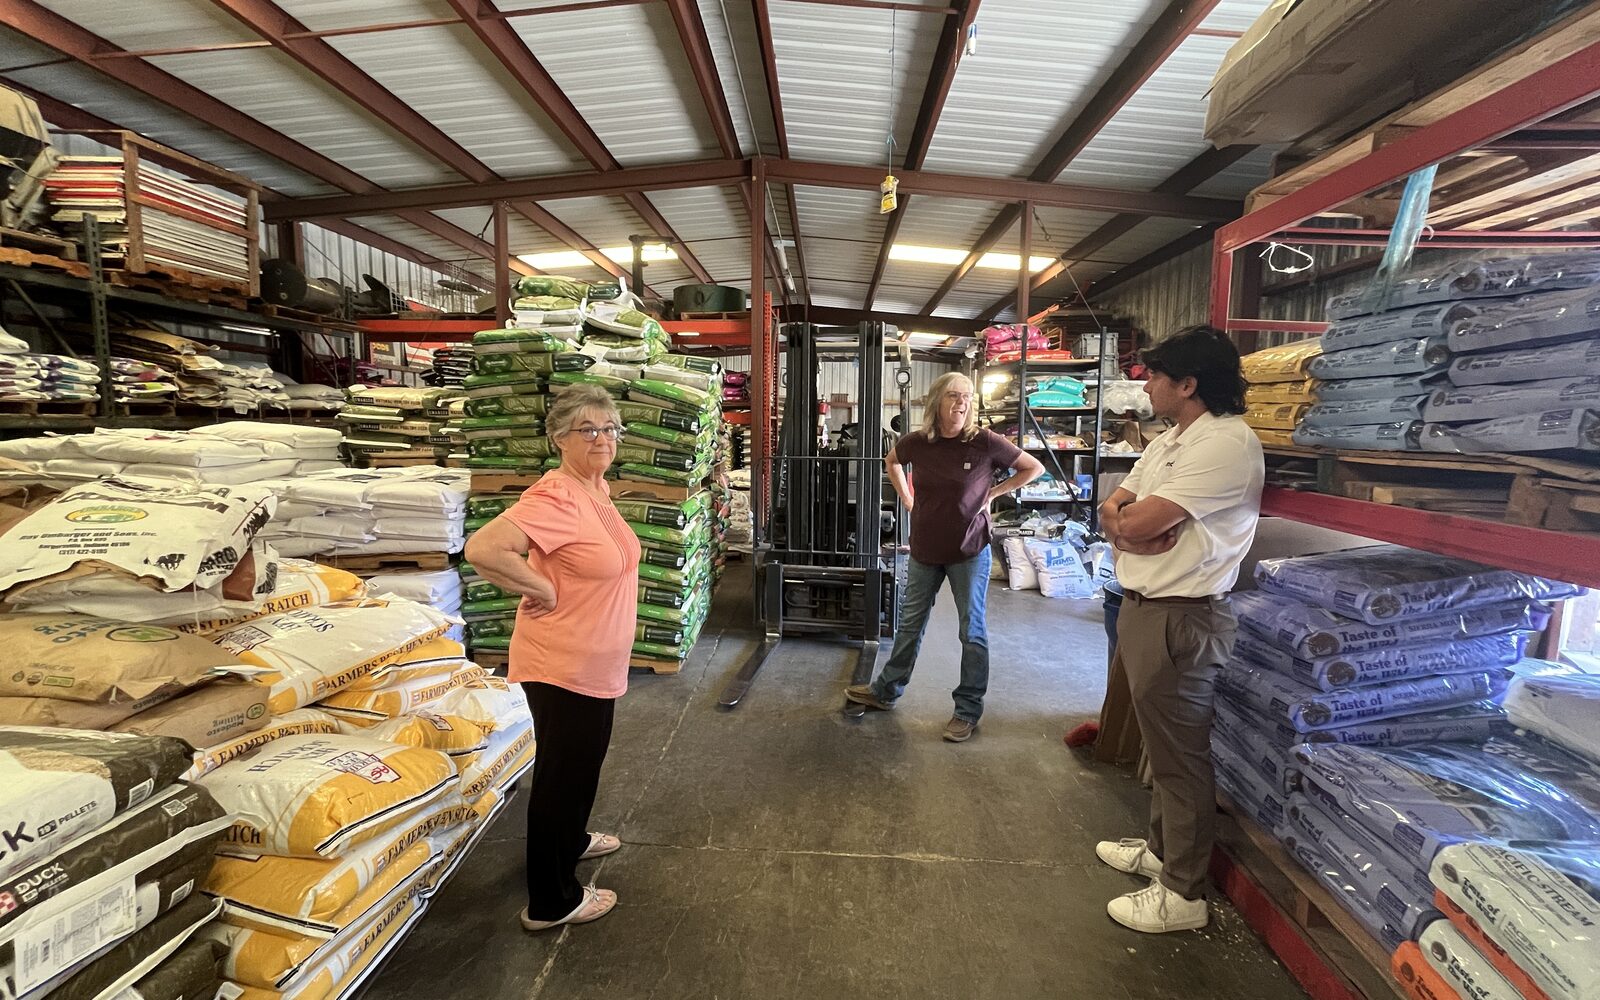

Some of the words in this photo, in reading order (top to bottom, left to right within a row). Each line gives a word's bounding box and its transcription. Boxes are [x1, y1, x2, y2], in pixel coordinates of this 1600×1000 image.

[1339, 630, 1379, 645] Taste
[1382, 625, 1398, 639] of
[1356, 660, 1393, 673] Taste
[1395, 655, 1408, 668] of
[1331, 698, 1368, 713] Taste
[1370, 694, 1383, 706] of
[1333, 711, 1354, 722] the
[206, 719, 246, 737] Modesto
[1339, 730, 1376, 743] Taste
[1379, 727, 1392, 740] of
[58, 800, 97, 825] PELLETS
[14, 862, 64, 895] DUCK
[1463, 876, 1486, 903] Taste
[1487, 904, 1501, 916] of
[1540, 882, 1596, 927] STREAM
[1450, 955, 1475, 985] Taste
[1476, 986, 1490, 999] of
[1540, 952, 1576, 989] STREAM
